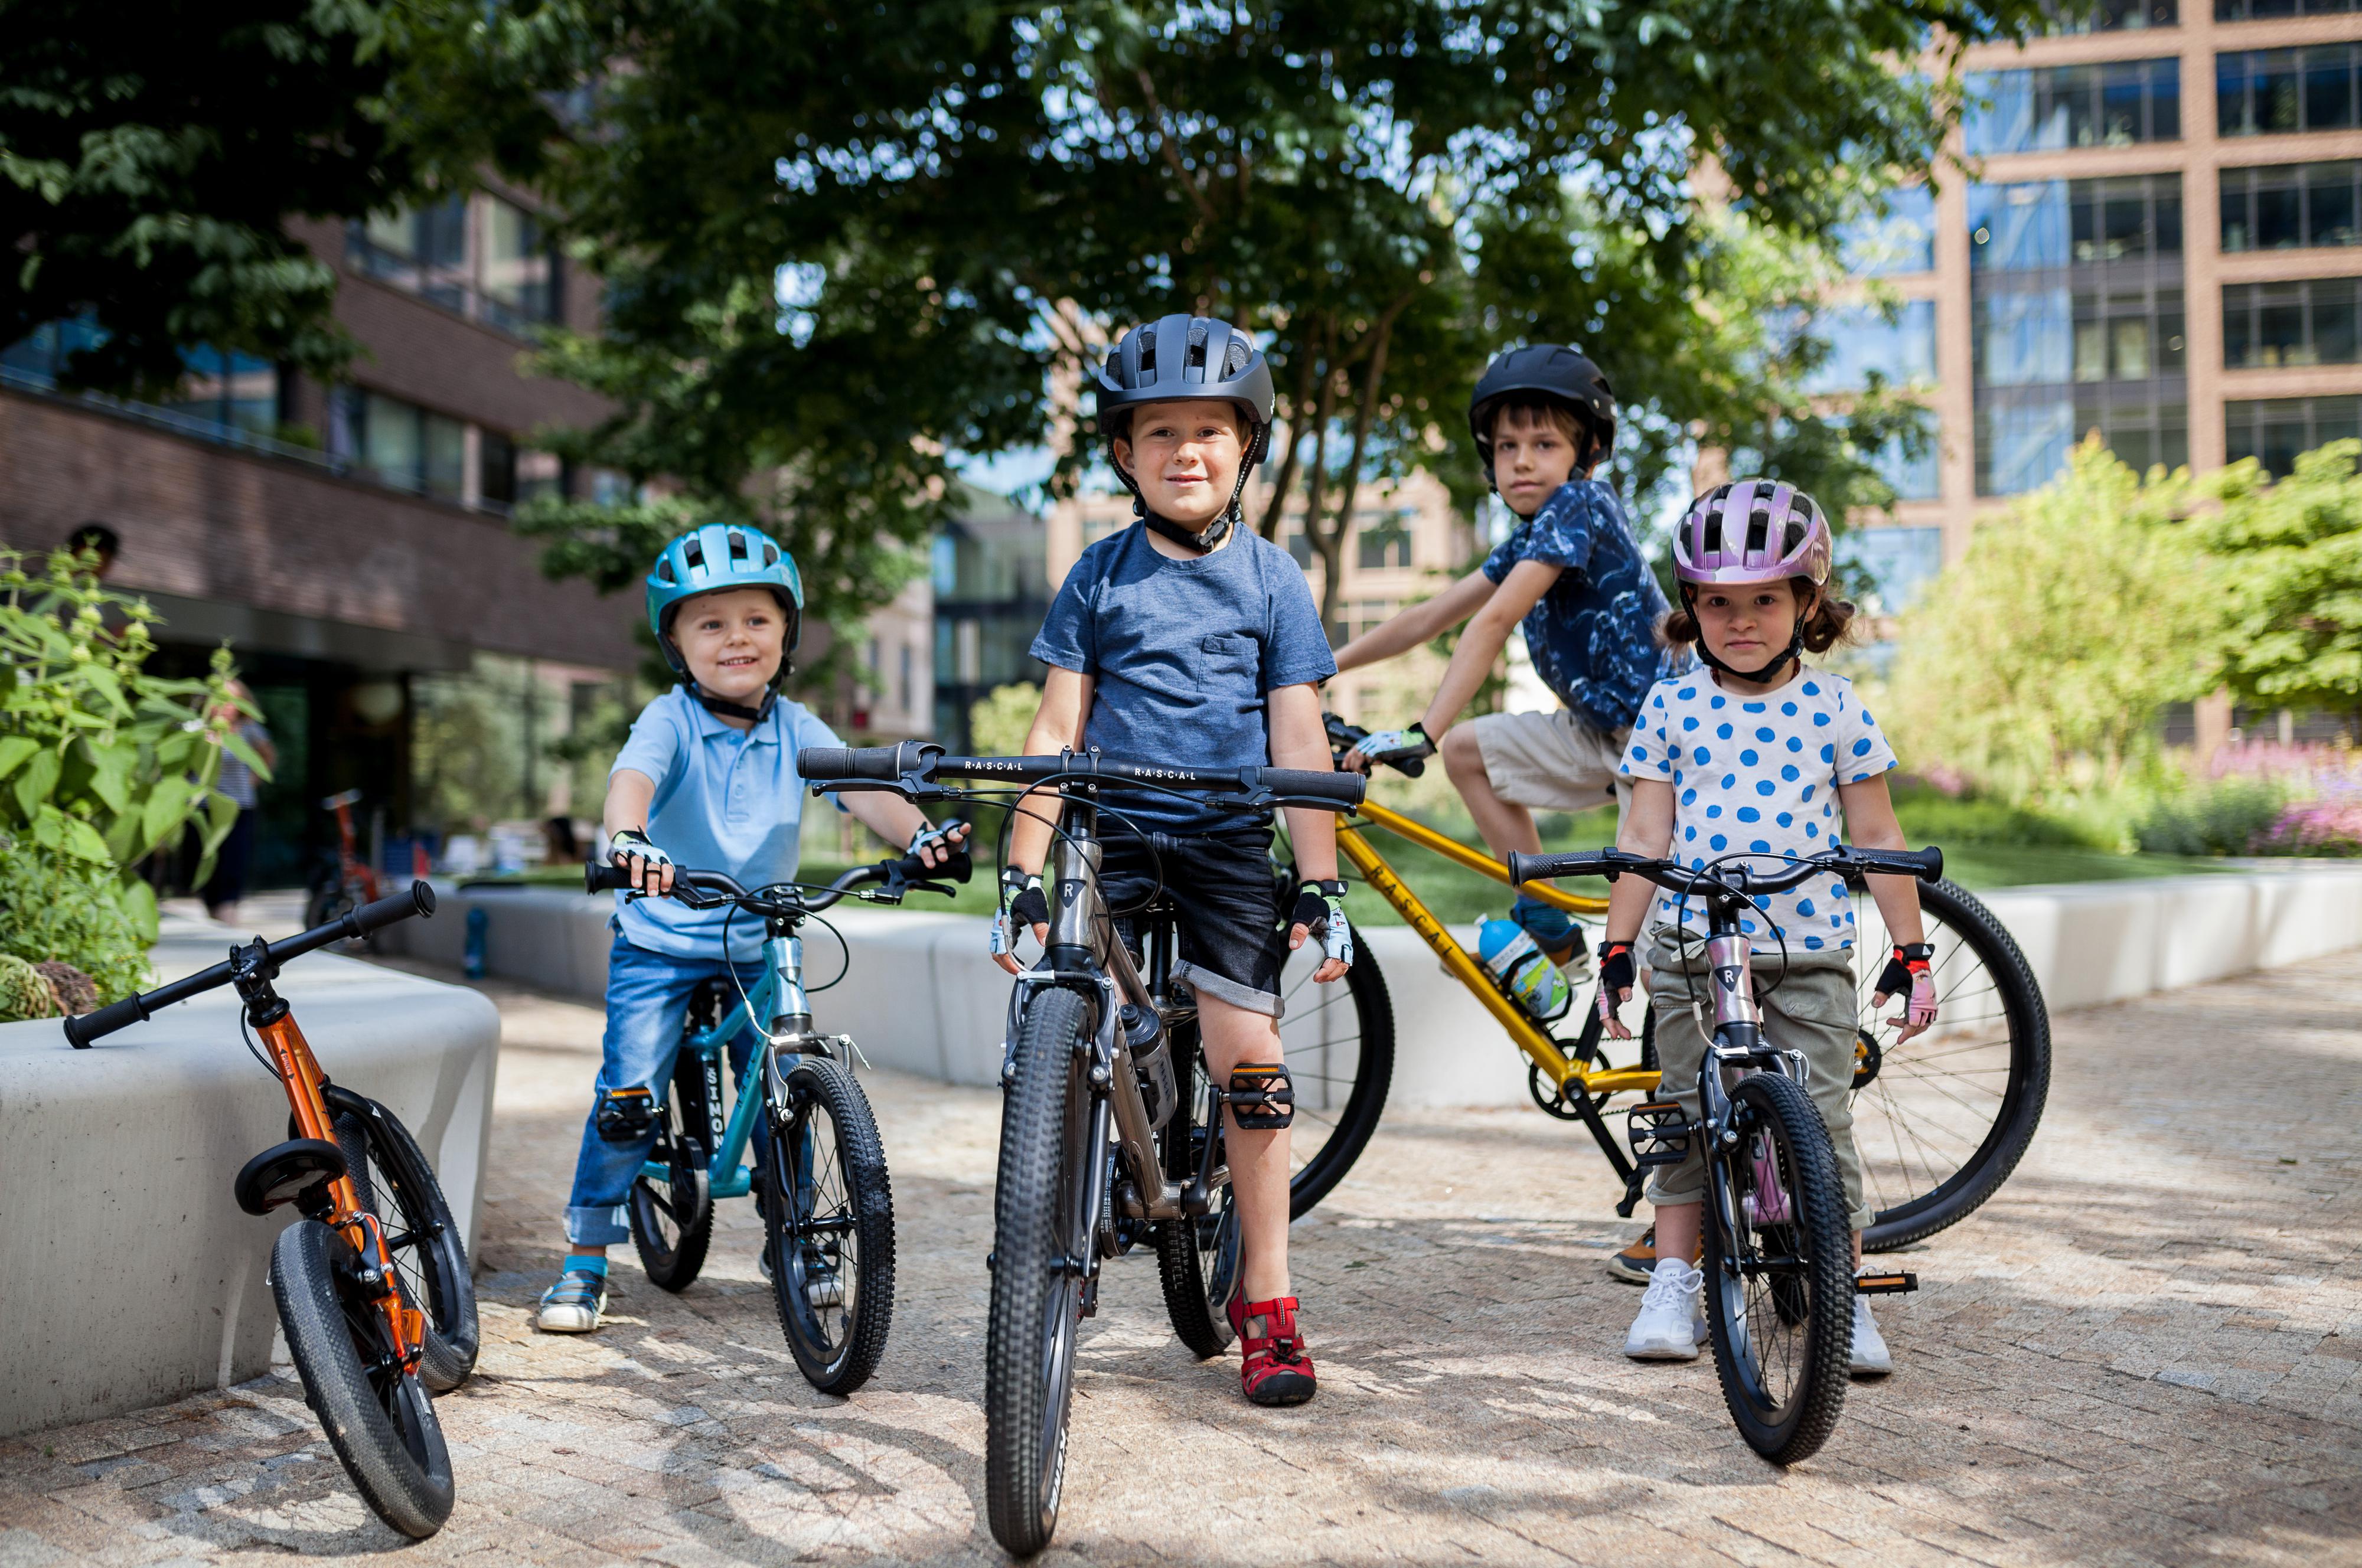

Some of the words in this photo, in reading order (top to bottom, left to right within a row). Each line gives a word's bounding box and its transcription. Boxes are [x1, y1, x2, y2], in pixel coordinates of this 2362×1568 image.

[1064, 883, 1074, 897] R
[1724, 970, 1734, 983] R
[1048, 1427, 1066, 1517] KENDA
